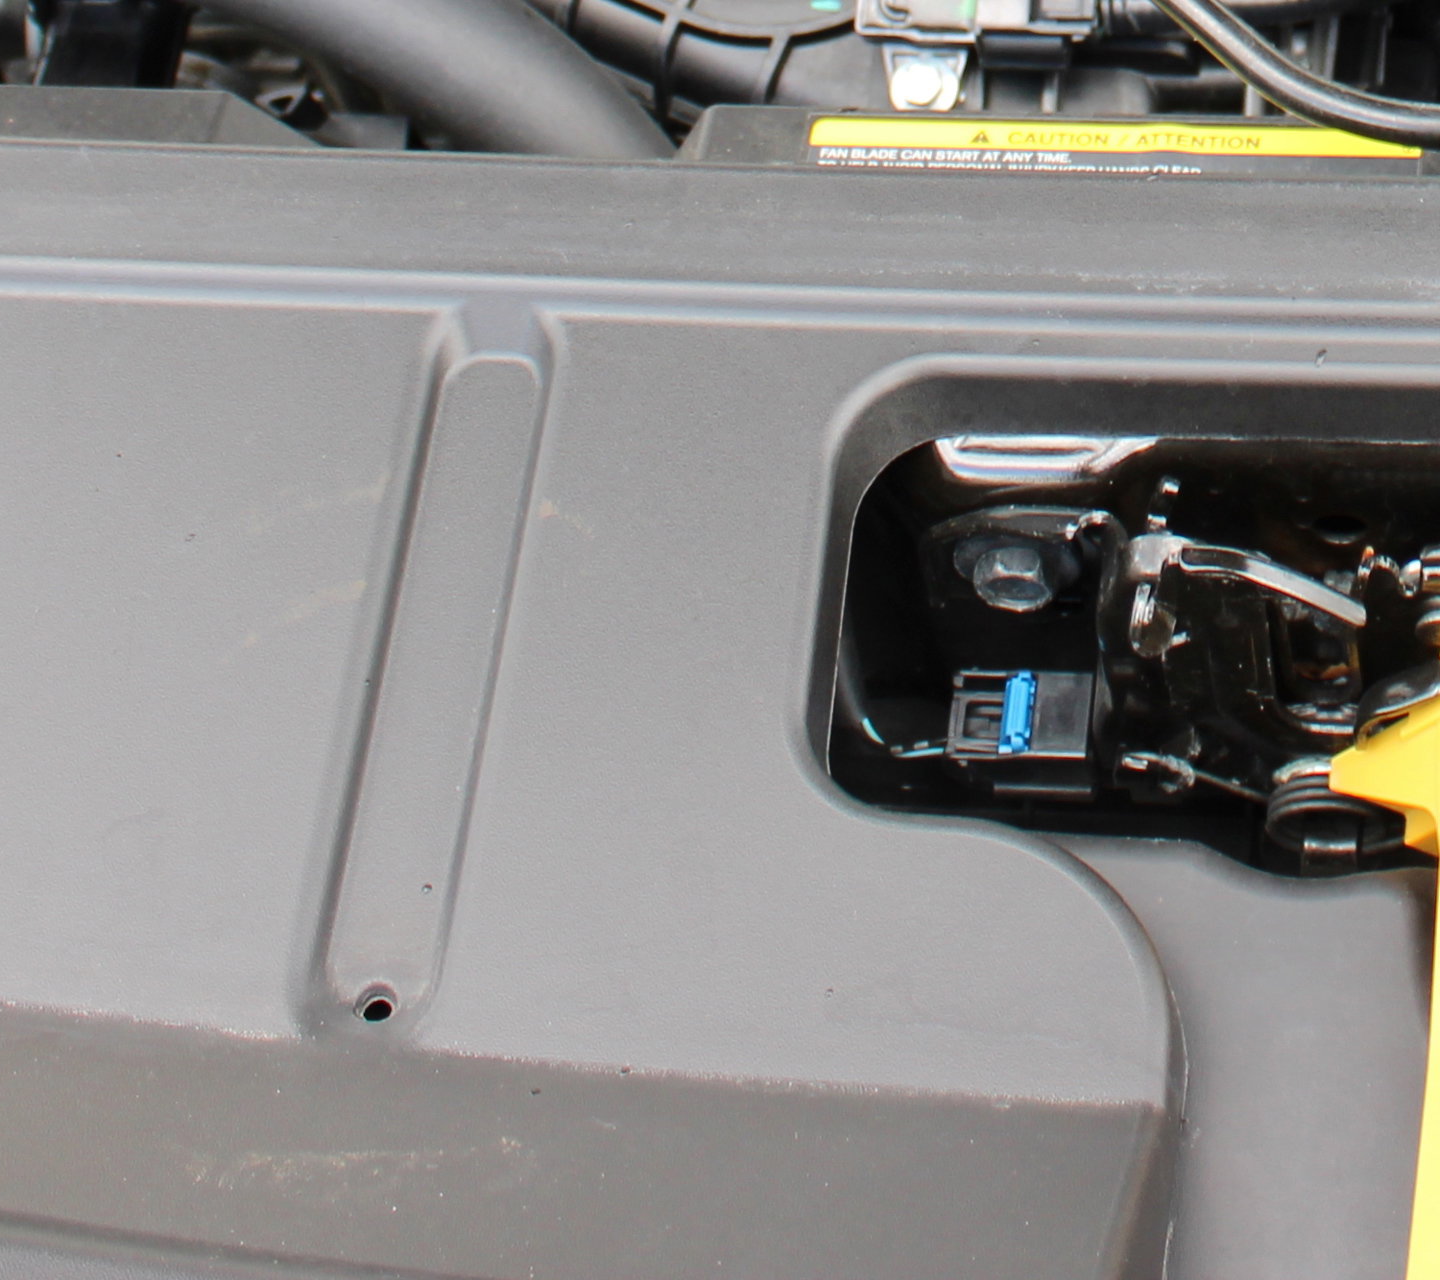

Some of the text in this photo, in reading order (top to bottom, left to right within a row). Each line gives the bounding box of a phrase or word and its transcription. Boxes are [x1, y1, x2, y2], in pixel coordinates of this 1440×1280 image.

[1008, 131, 1109, 147] CAUTION
[1136, 133, 1261, 149] ATTENTION
[819, 147, 1072, 164] FAN BLADE CAN START AT ANY TIME.
